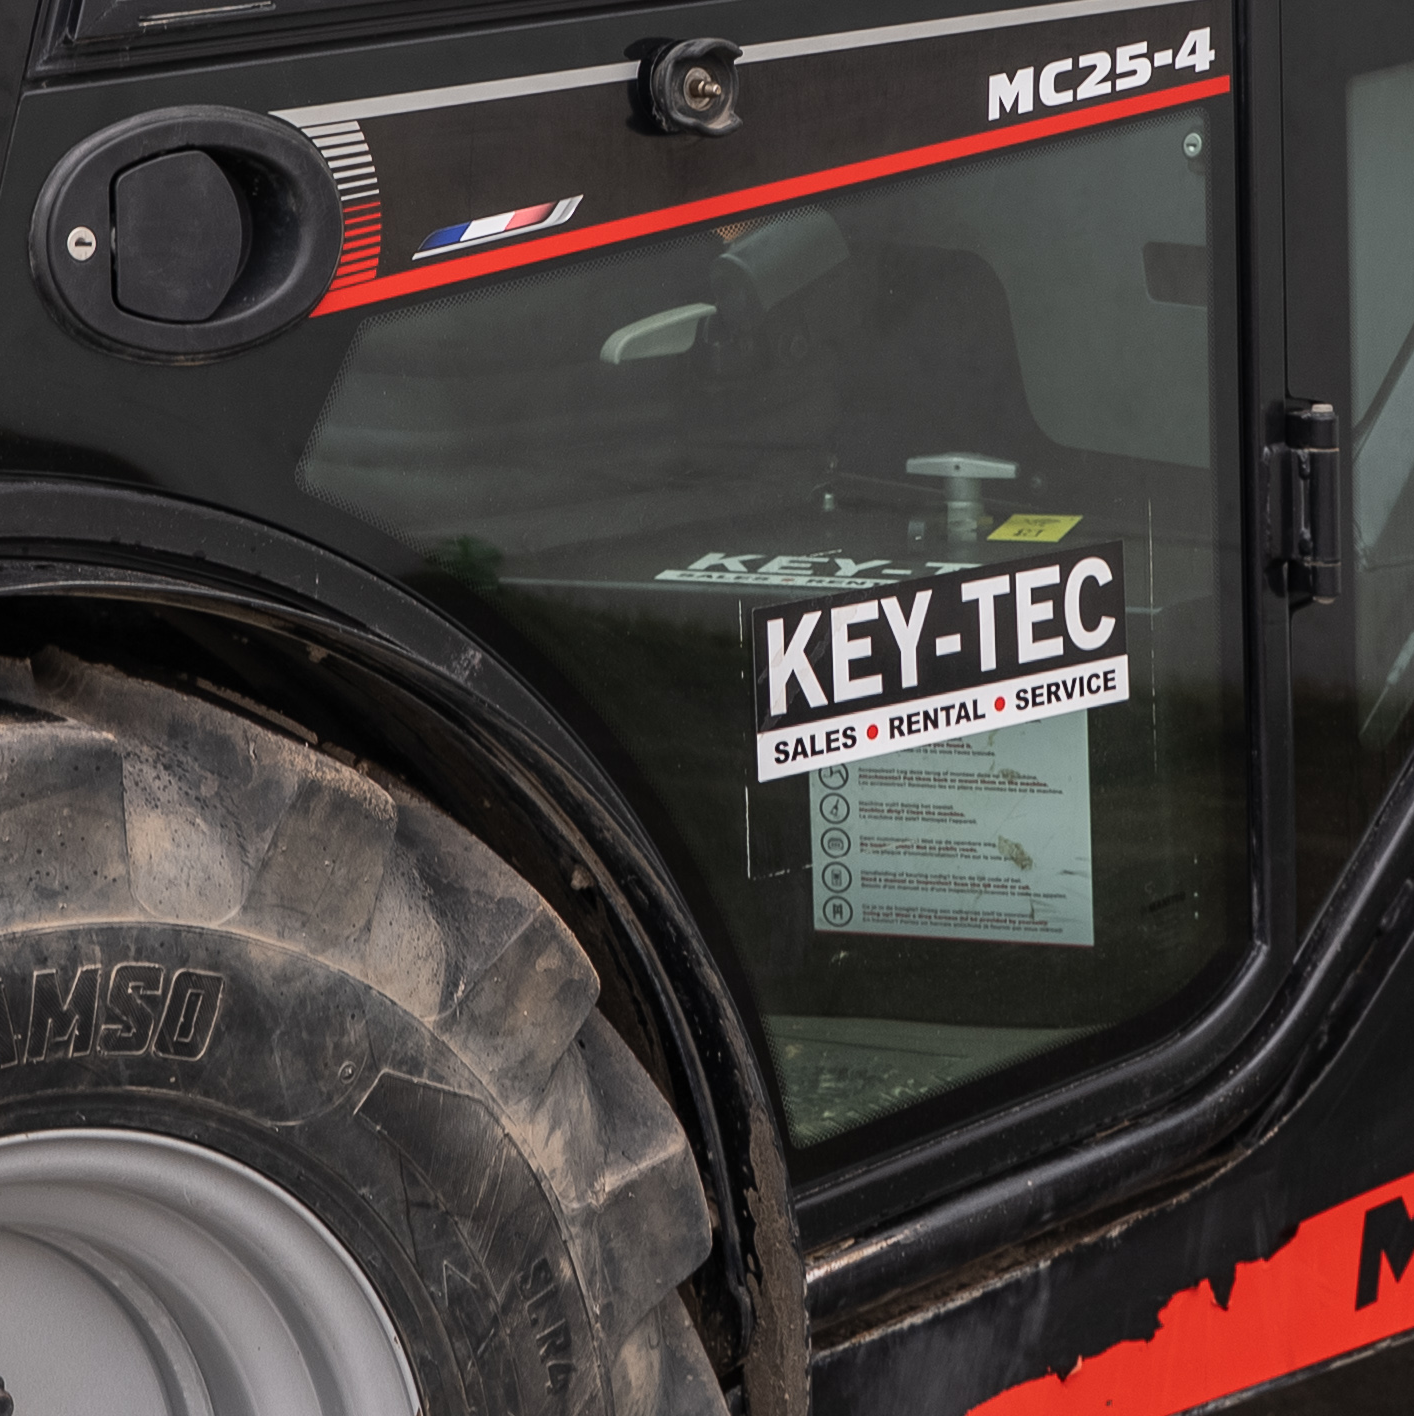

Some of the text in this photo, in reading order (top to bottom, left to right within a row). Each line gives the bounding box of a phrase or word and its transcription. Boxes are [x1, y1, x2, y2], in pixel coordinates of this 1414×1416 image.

[988, 26, 1216, 121] MC25-4
[767, 556, 1116, 715] KEY-TEC
[774, 669, 1117, 765] SALES RENTAL SERVICE
